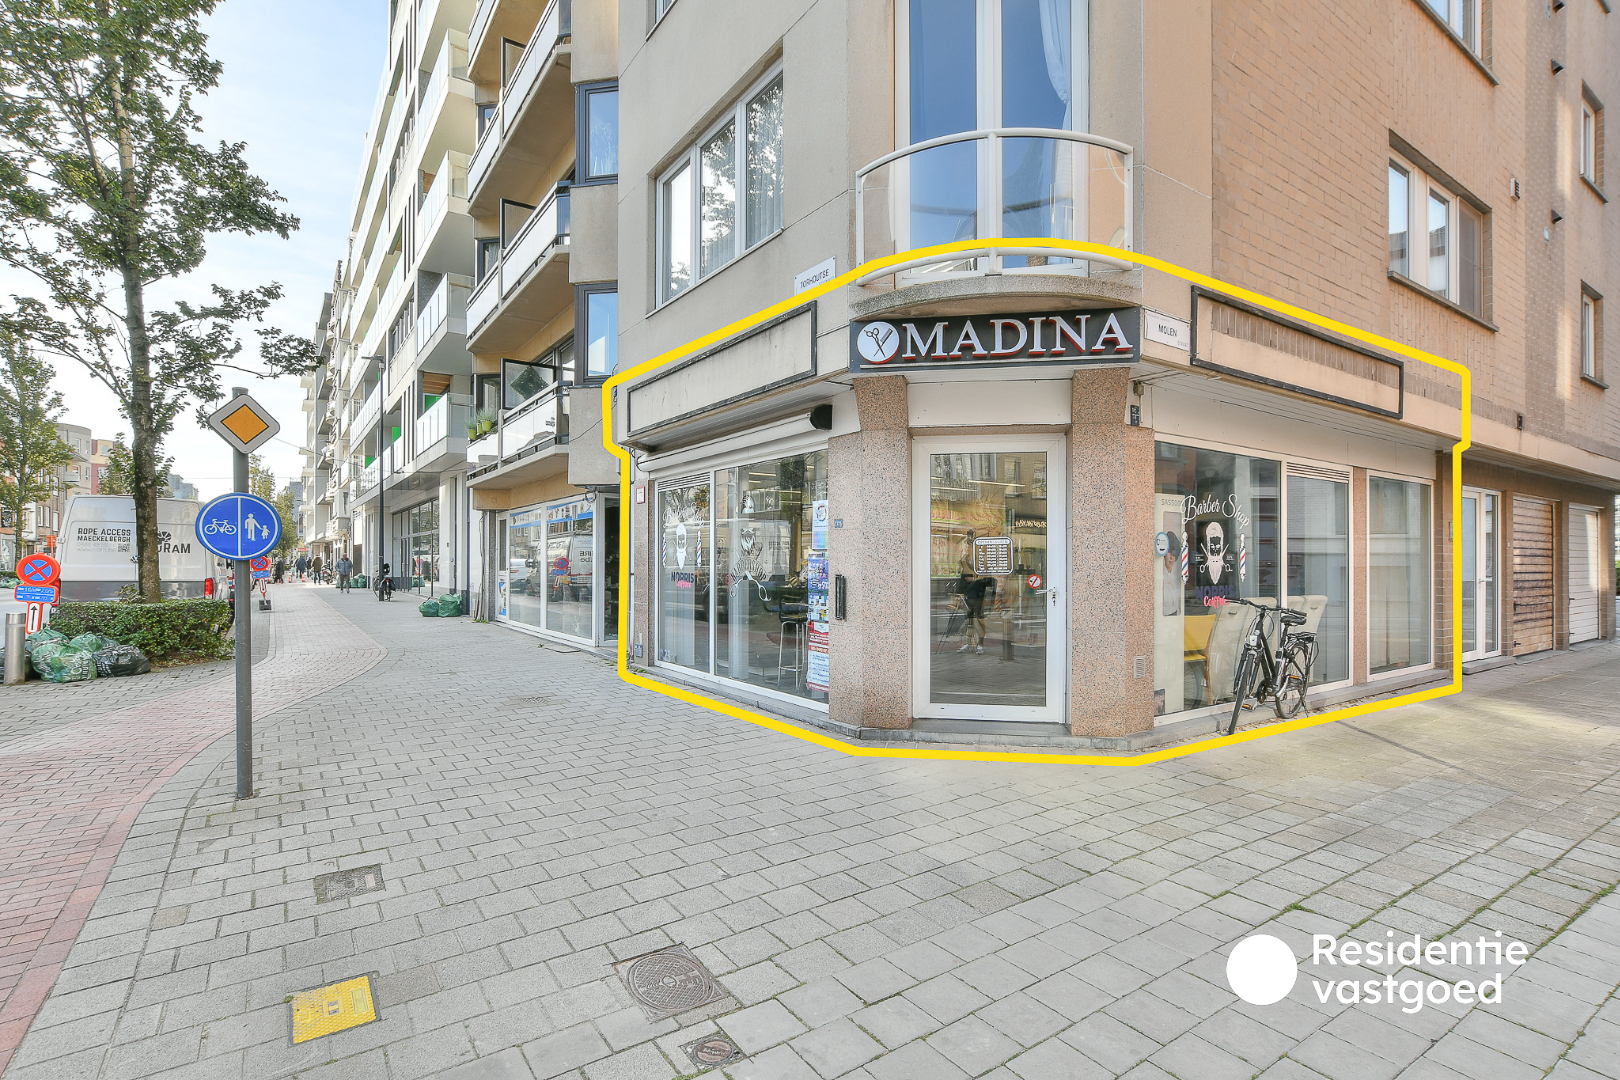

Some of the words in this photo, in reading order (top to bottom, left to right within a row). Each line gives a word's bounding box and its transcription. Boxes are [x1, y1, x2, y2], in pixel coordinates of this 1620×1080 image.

[901, 312, 1134, 361] MADINA
[1158, 323, 1178, 338] MOLEN
[1180, 493, 1221, 525] Barber
[1222, 493, 1250, 530] Shop
[77, 527, 98, 536] ROPE
[100, 529, 132, 537] ACCESS
[77, 535, 131, 543] MAECKELBERGH
